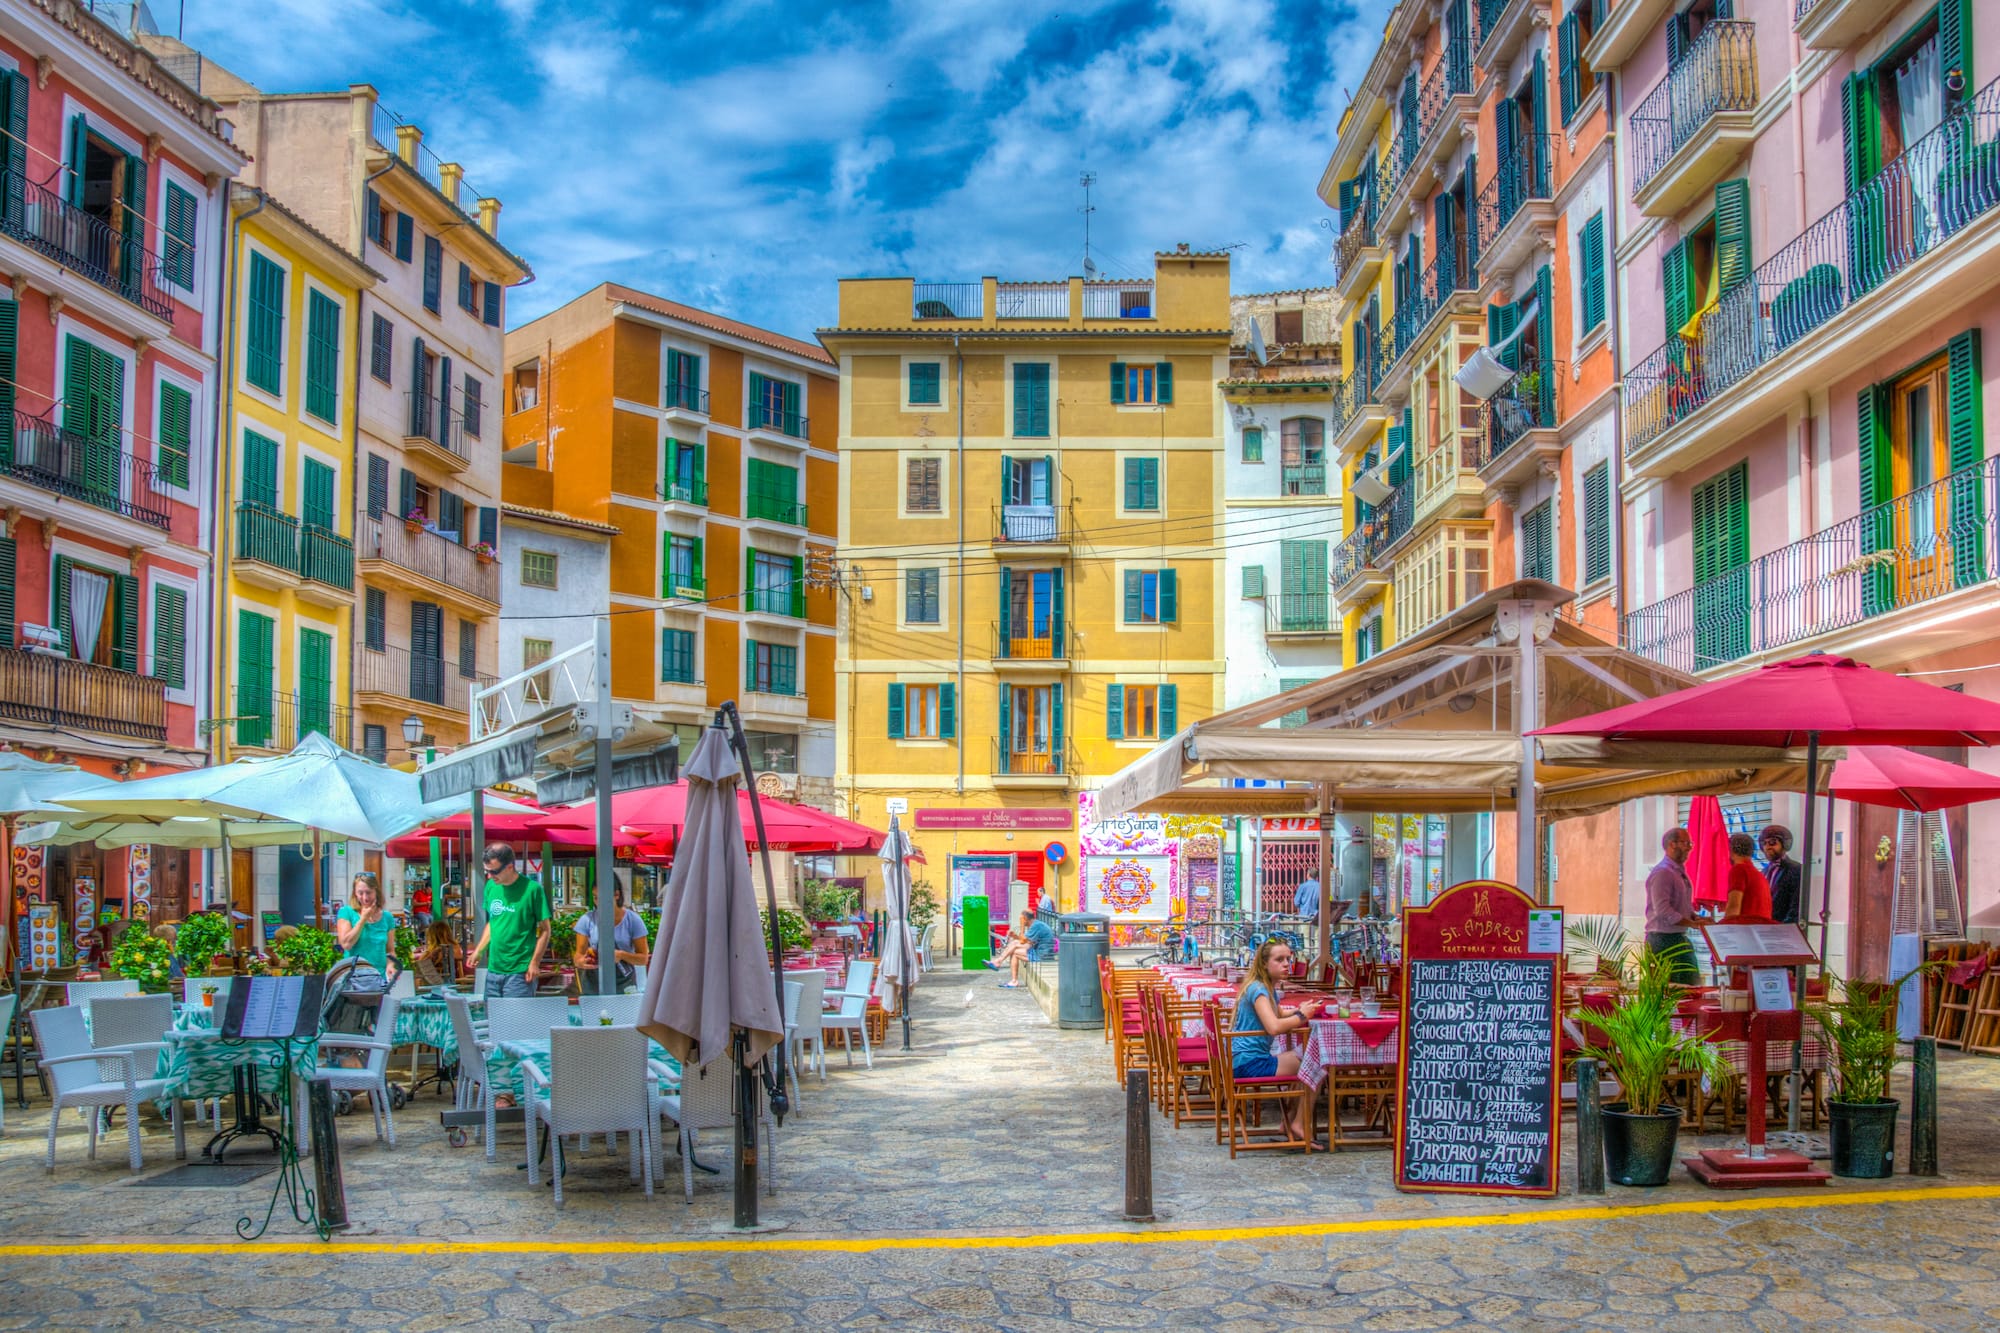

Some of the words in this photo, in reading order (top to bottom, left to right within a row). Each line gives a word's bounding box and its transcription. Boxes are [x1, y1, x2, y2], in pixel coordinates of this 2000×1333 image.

[1464, 918, 1524, 943] AMBROS
[1442, 945, 1486, 953] TRATTORIA
[1458, 972, 1491, 986] FRESCO
[1490, 961, 1551, 982] GENOVESE
[1459, 961, 1490, 973] PESTO
[1493, 981, 1550, 1001] VONGOLE
[1413, 1000, 1474, 1020] GAMBAS
[1506, 1003, 1549, 1023] PEREJIL
[1413, 1021, 1458, 1040] GNOCCHI
[1457, 1021, 1499, 1043] CASERI
[1414, 1041, 1469, 1060] SPAGHETTI
[1484, 1042, 1551, 1062] CARBONARA
[1410, 1098, 1472, 1121] LUBINA
[1485, 1101, 1532, 1112] PATATAS
[1479, 1111, 1542, 1124] ACEITUNAS
[1484, 1130, 1549, 1147] PARMIGIANA
[1410, 1140, 1478, 1162] TARTARO
[1408, 1162, 1479, 1183] SPAGHETTI
[1481, 1173, 1525, 1186] MARE
